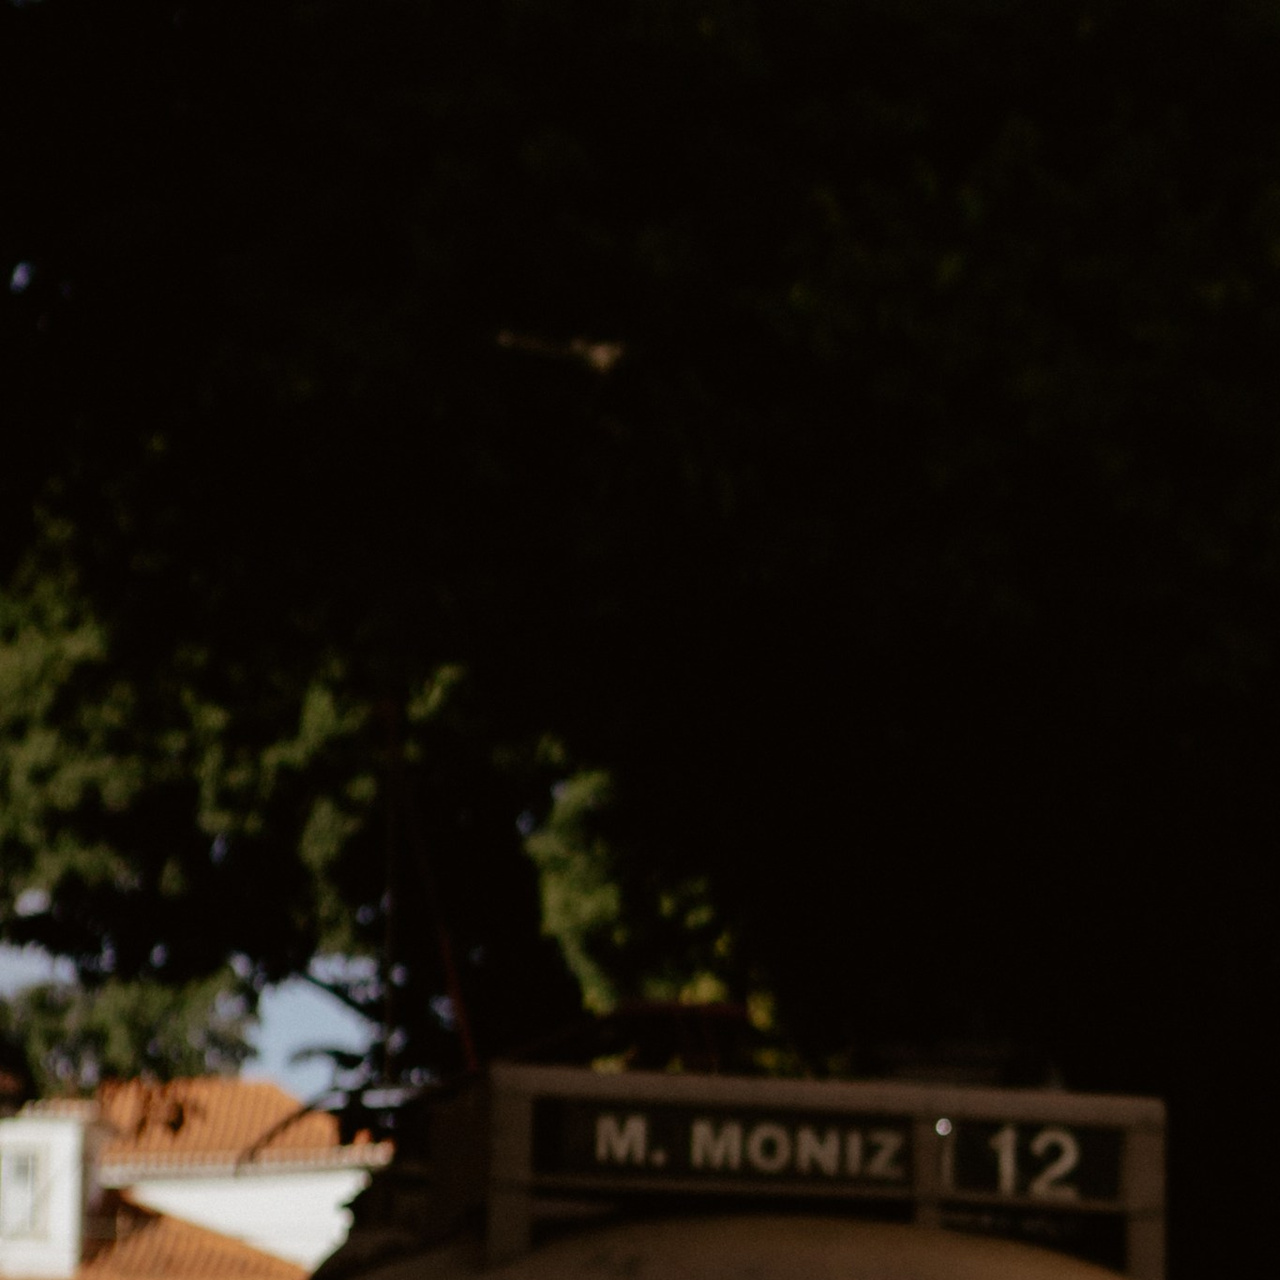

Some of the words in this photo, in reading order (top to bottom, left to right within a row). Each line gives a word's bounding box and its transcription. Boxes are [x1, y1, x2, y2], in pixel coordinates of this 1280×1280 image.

[594, 1113, 668, 1168] M.
[690, 1118, 902, 1181] MONIZ
[990, 1127, 1082, 1201] 12
